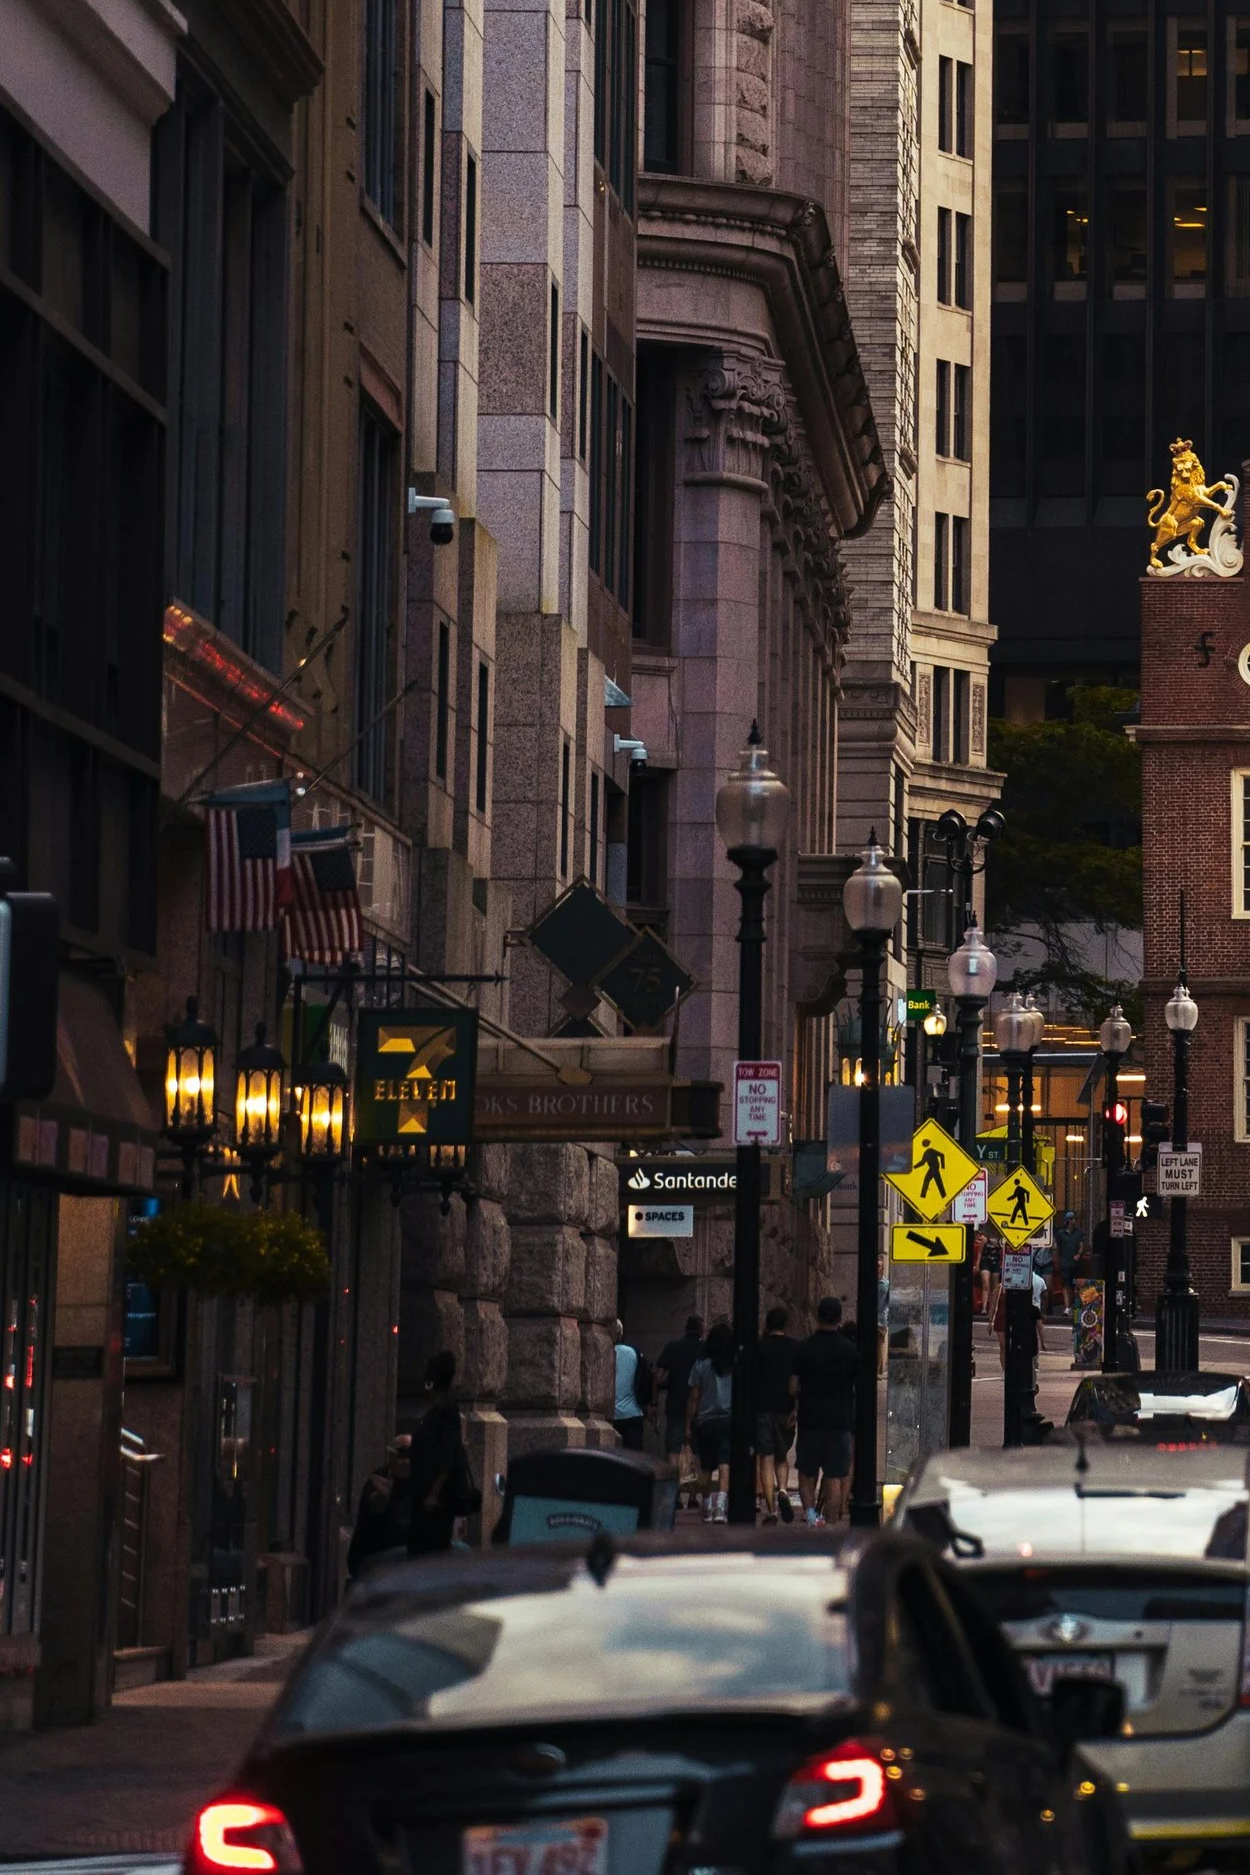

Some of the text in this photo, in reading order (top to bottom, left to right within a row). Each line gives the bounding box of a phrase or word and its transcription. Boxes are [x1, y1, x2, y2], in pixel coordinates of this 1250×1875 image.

[630, 967, 662, 993] 75
[908, 1000, 931, 1010] Bank
[738, 1067, 778, 1077] TOW ZONE
[378, 1026, 457, 1133] 7
[749, 1084, 766, 1095] NO
[528, 1094, 654, 1115] BROTHERS
[740, 1096, 776, 1105] STOPPING
[749, 1114, 766, 1122] TIME
[1161, 1157, 1198, 1167] LEFT LANE
[1165, 1169, 1194, 1179] MUST
[1161, 1181, 1198, 1191] TURN LEFT
[645, 1211, 685, 1221] SPACES
